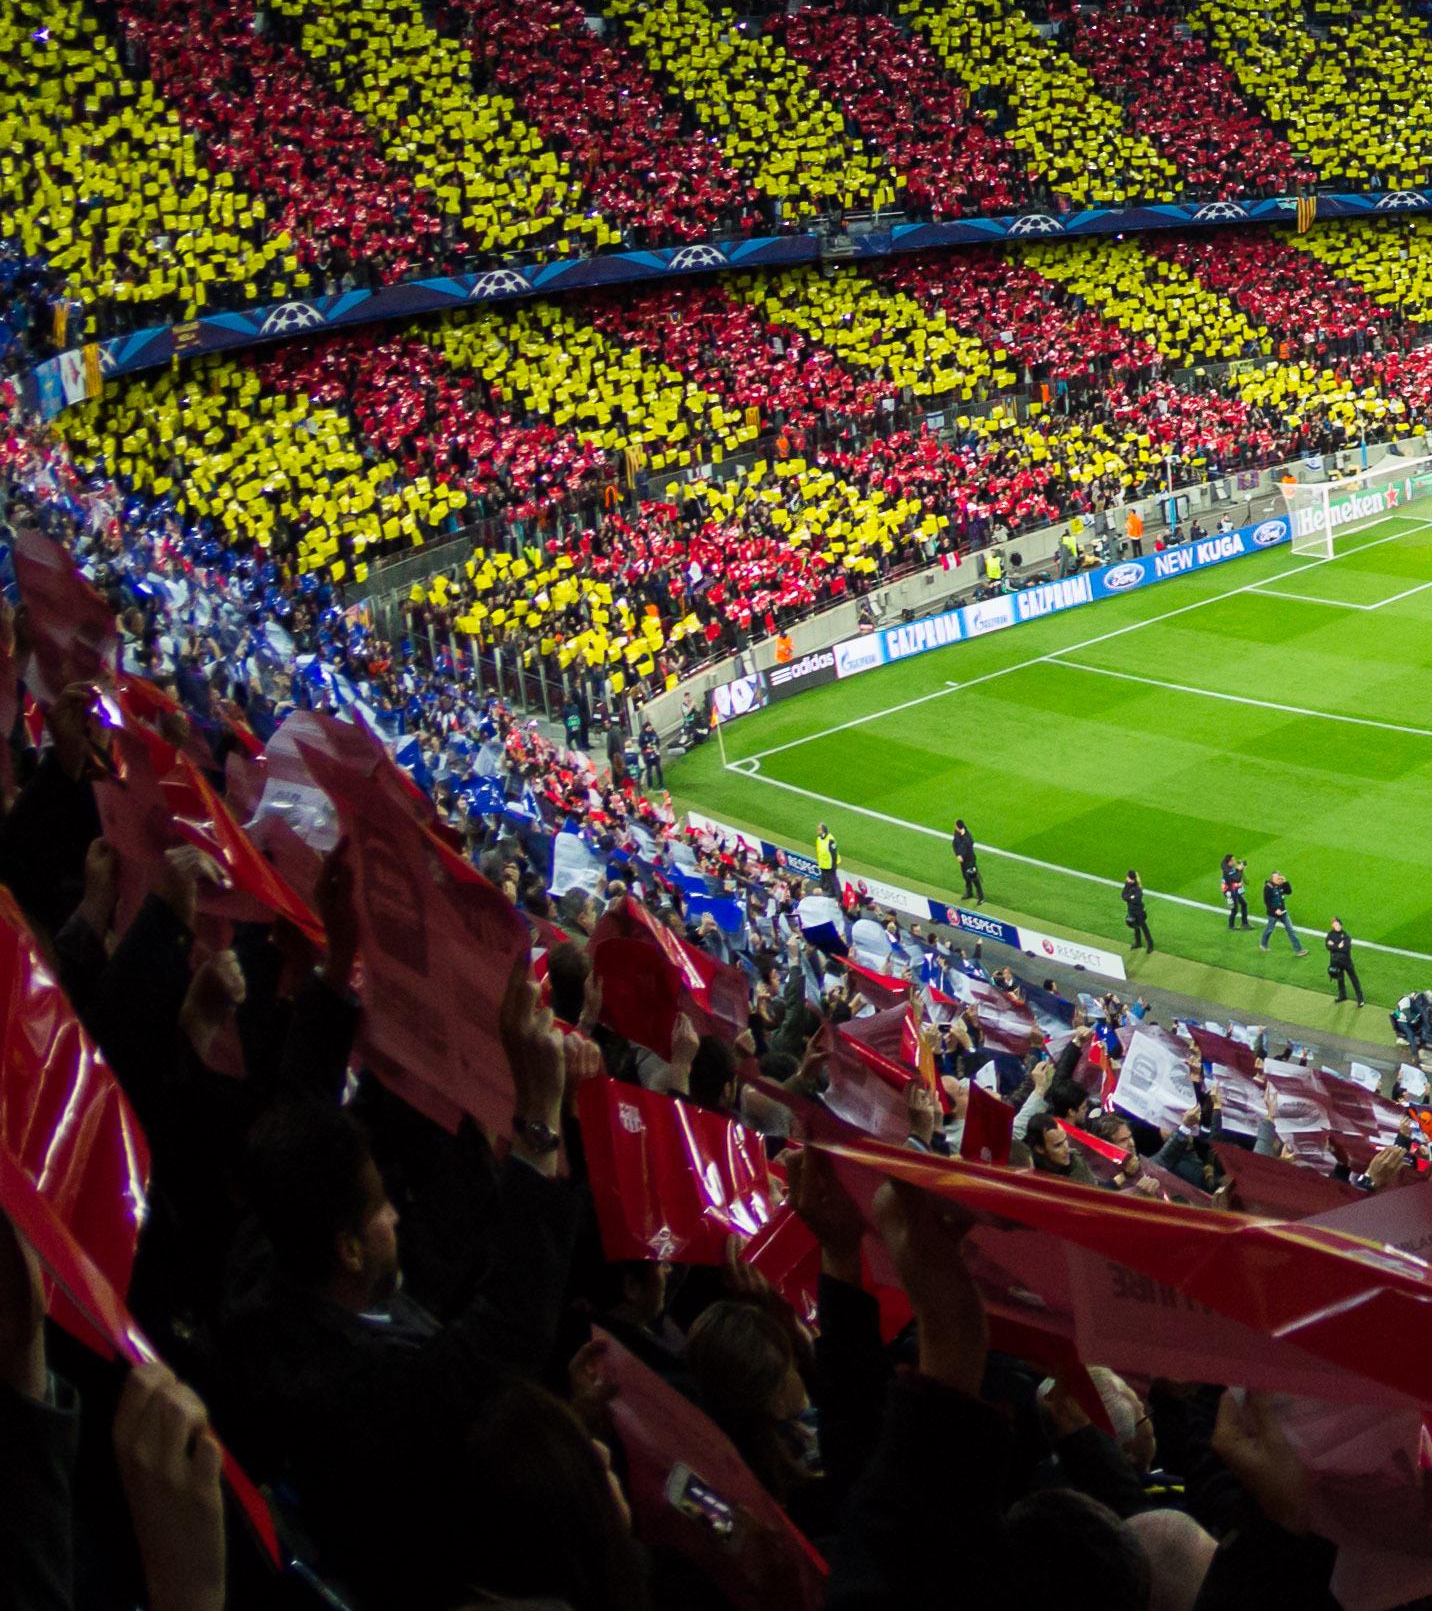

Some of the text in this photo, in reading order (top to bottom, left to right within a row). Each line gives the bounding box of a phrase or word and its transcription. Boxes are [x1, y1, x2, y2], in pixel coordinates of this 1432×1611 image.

[1154, 533, 1244, 577] NEW KUGA
[1017, 573, 1090, 612] GAZPROM
[886, 613, 963, 660] GAZPROM
[791, 649, 835, 680] adidas
[868, 885, 908, 907] RESPECT
[961, 913, 1004, 939] RESPECT
[1057, 945, 1103, 967] RESPECT
